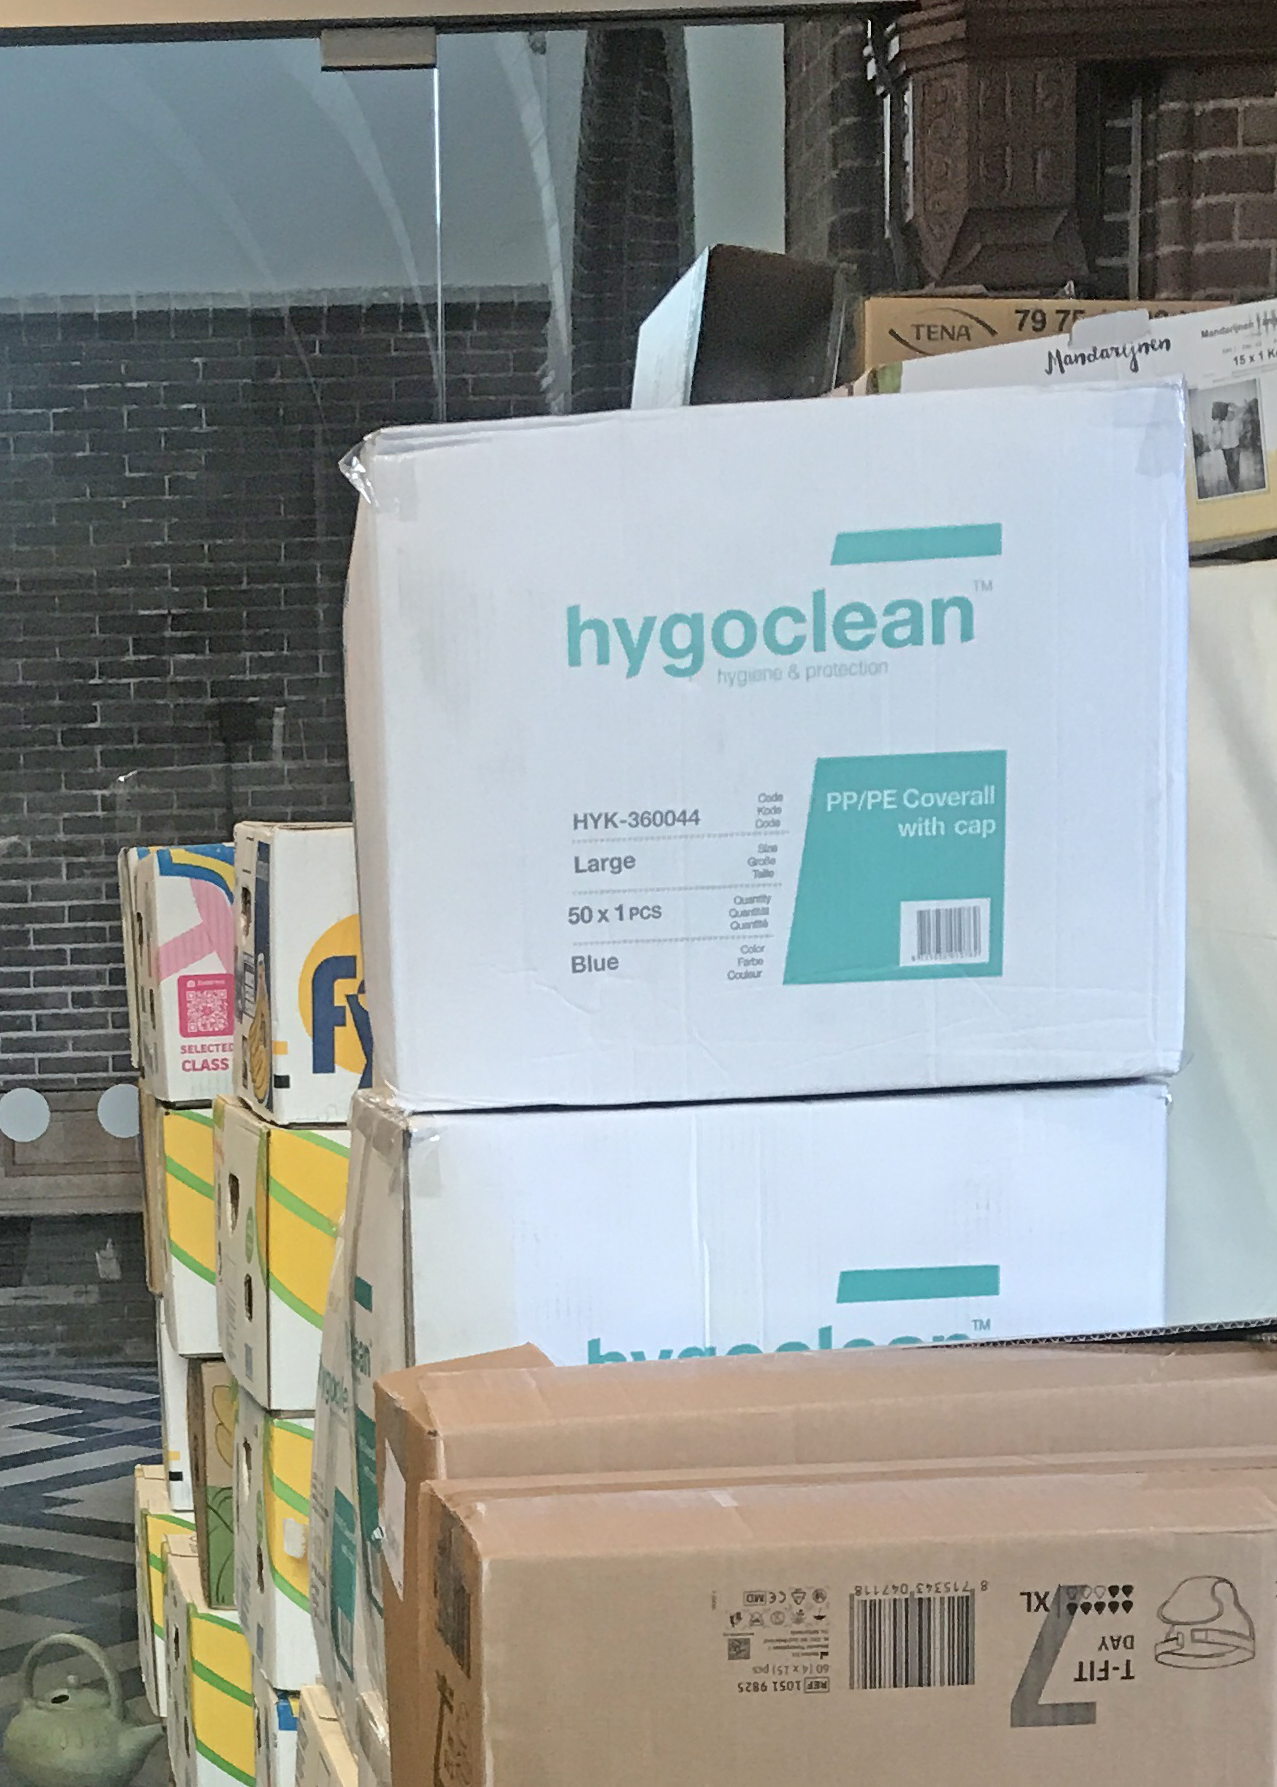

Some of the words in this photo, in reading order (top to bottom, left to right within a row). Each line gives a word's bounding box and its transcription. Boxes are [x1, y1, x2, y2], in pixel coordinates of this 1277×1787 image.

[1014, 309, 1047, 332] 79
[911, 322, 973, 342] TENA
[1233, 355, 1246, 366] 15
[566, 587, 975, 679] hygoclean
[717, 664, 783, 687] hygiene
[787, 663, 801, 680] &
[805, 658, 889, 682] protection
[758, 792, 784, 803] Code
[826, 789, 898, 812] PP/PE
[903, 784, 996, 809] Coverall
[573, 808, 701, 831] HYK-360044
[757, 805, 782, 816] Kode
[898, 816, 946, 838] with
[954, 818, 997, 838] cap
[574, 854, 636, 875] Large
[568, 906, 593, 925] 50
[597, 908, 609, 923] x
[614, 904, 624, 922] 1
[629, 905, 662, 921] PCS
[740, 944, 765, 955] Color
[571, 955, 619, 974] Blue
[737, 956, 764, 967] Farbe
[727, 969, 763, 981] Couleur
[181, 1057, 229, 1073] CLASS
[854, 1582, 908, 1597] 047118
[915, 1579, 970, 1595] 715343
[1019, 1590, 1051, 1613] XL
[1097, 1634, 1135, 1652] DAY
[1010, 1584, 1098, 1728] 7
[1073, 1658, 1135, 1683] T-FIT
[738, 1681, 768, 1693] 9825
[772, 1680, 801, 1691] 1051
